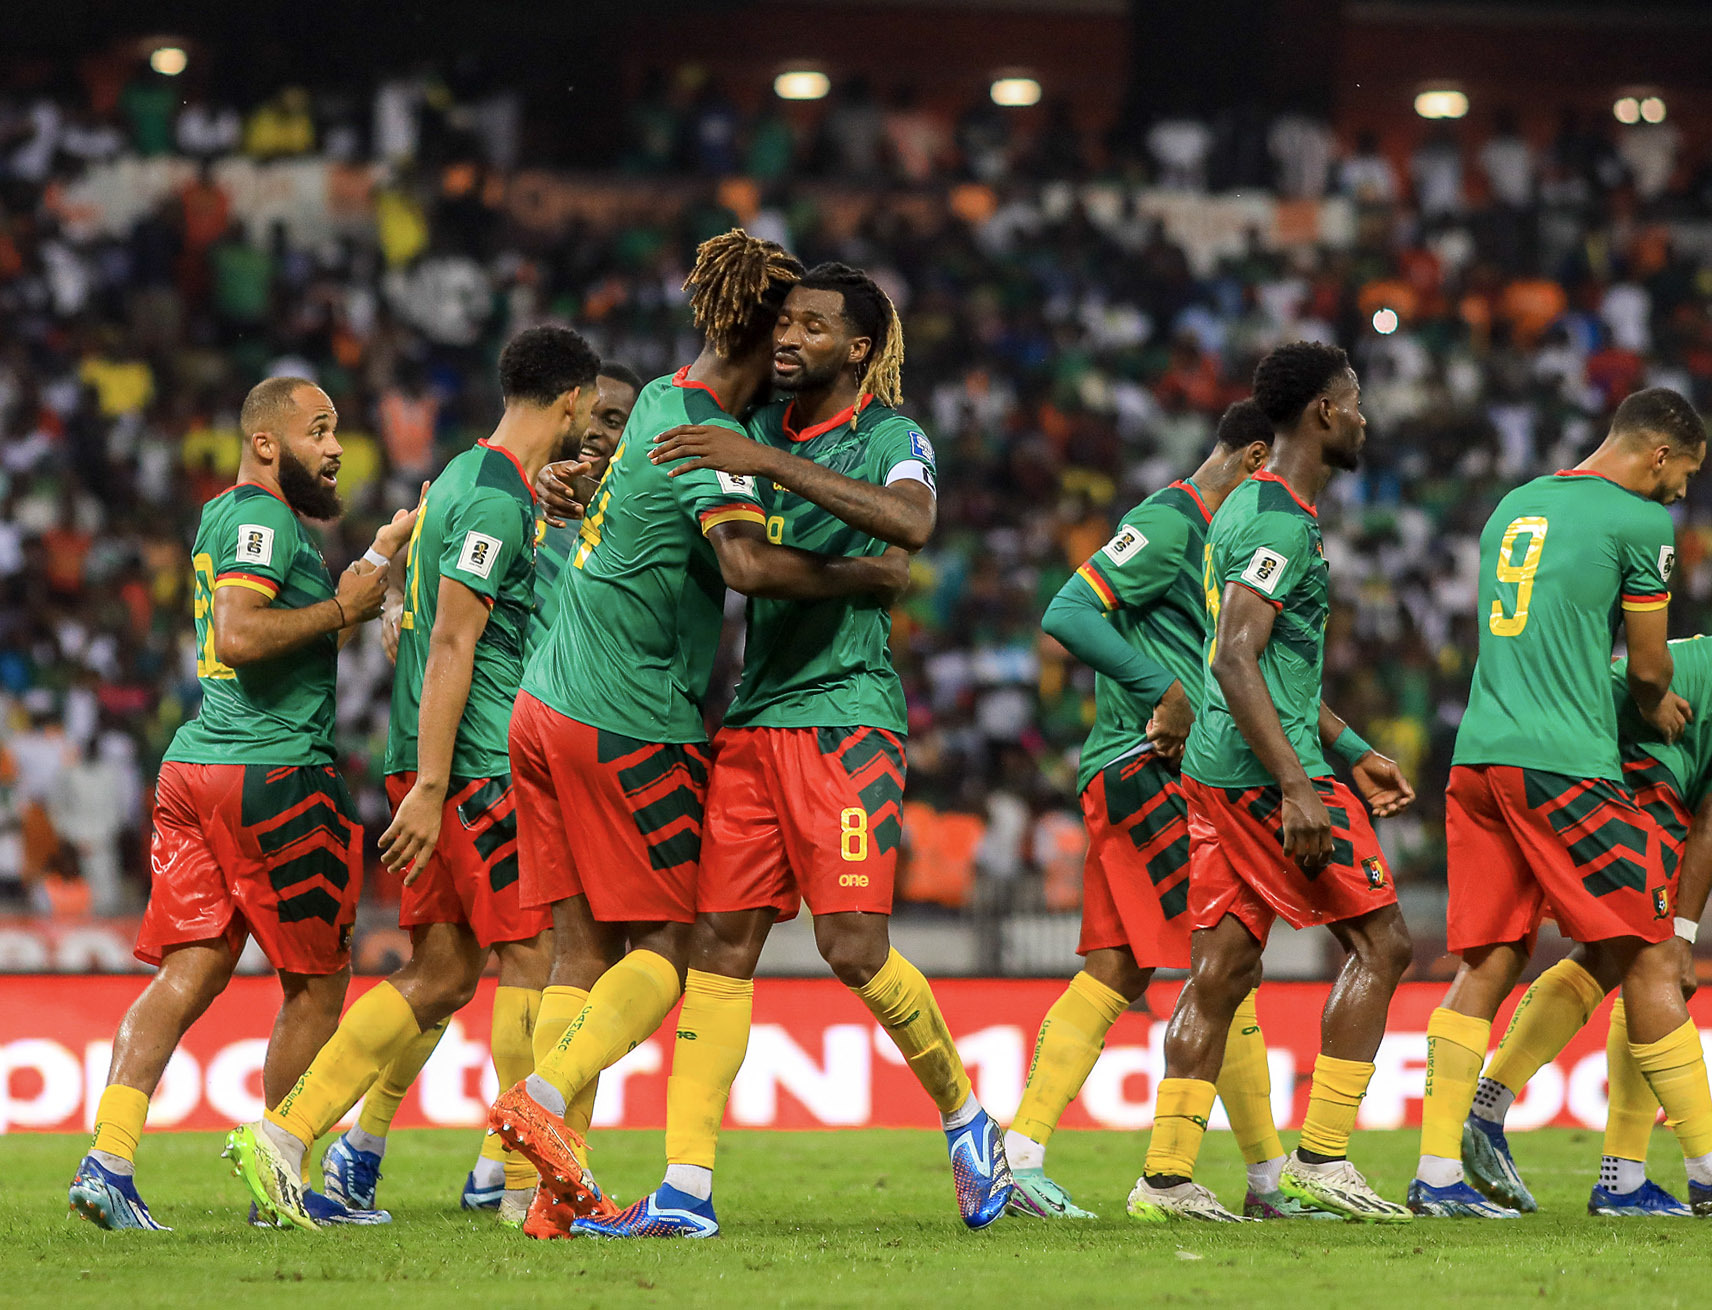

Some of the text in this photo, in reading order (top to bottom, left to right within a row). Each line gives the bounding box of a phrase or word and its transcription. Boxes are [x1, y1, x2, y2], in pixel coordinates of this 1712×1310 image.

[1489, 516, 1548, 637] 9
[840, 807, 868, 861] 8
[839, 873, 869, 888] one
